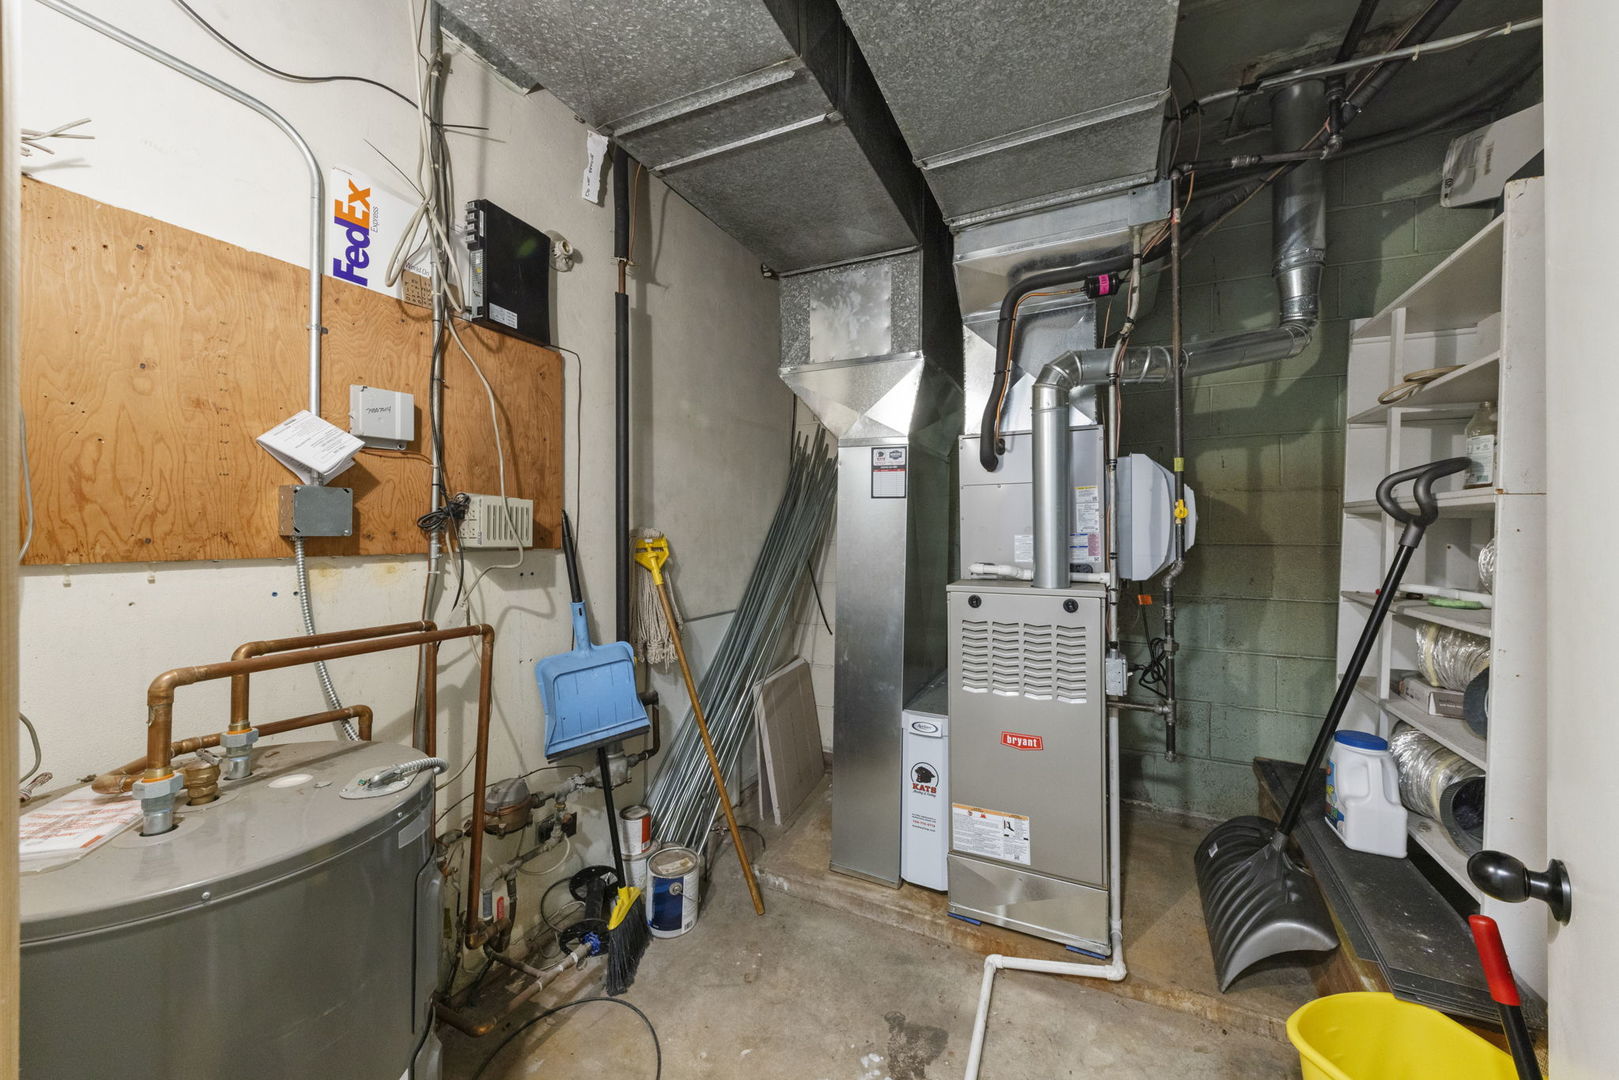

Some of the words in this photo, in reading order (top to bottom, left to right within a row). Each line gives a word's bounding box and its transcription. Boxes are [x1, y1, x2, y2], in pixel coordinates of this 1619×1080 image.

[371, 206, 380, 234] Express
[333, 179, 371, 287] FedEx
[1006, 735, 1038, 748] bryant
[912, 783, 937, 793] KATS
